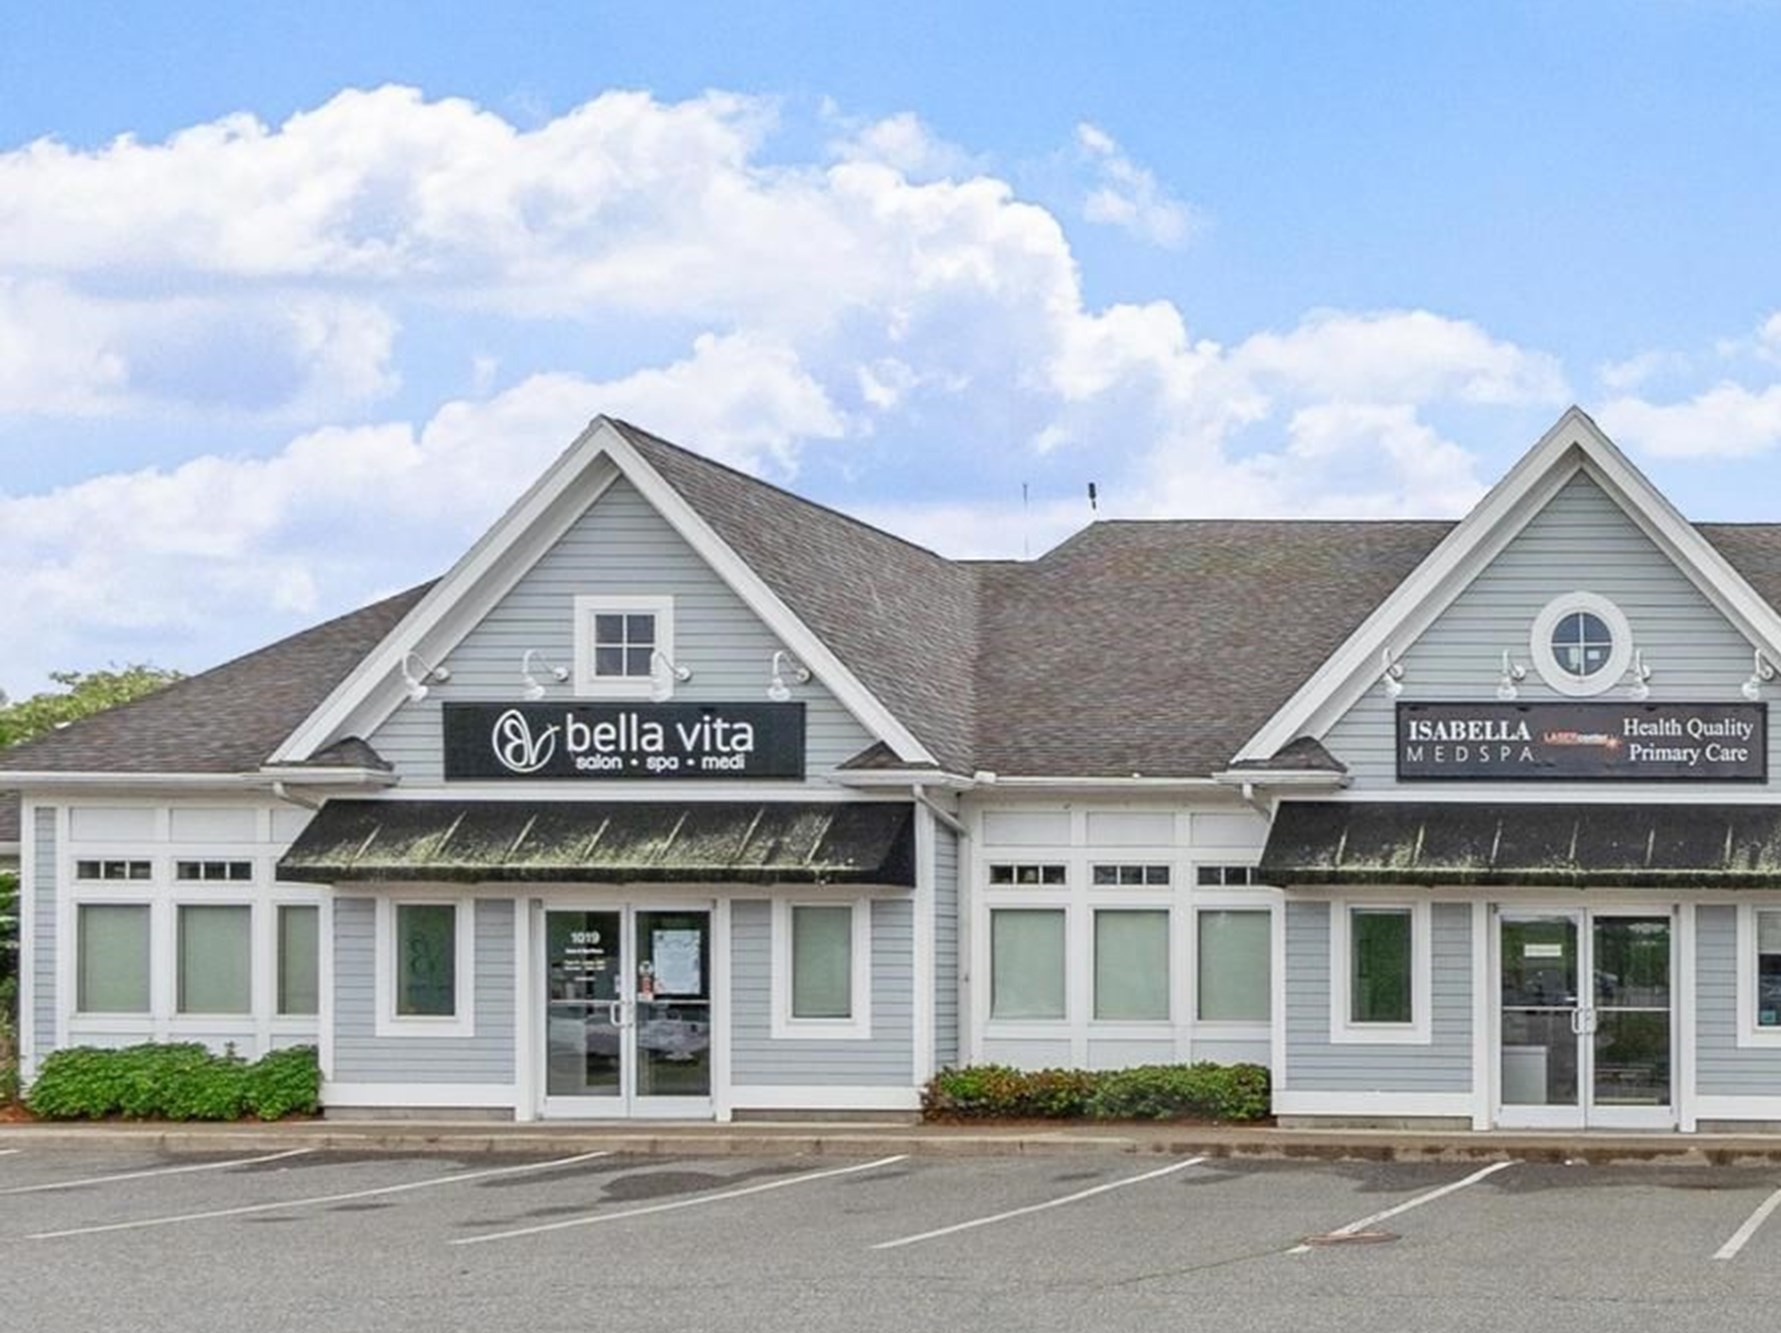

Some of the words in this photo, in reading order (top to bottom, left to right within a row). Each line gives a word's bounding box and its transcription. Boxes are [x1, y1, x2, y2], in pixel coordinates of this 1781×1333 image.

[566, 712, 664, 752] bella
[676, 714, 754, 751] vita
[1408, 720, 1532, 741] ISABELLA
[1623, 717, 1683, 736] Health
[1686, 717, 1754, 741] Quality
[576, 754, 623, 770] salon
[646, 756, 679, 773] spa
[701, 754, 746, 770] medi
[1629, 743, 1701, 766] Primary
[1705, 743, 1749, 762] Care
[570, 931, 600, 944] 1019
